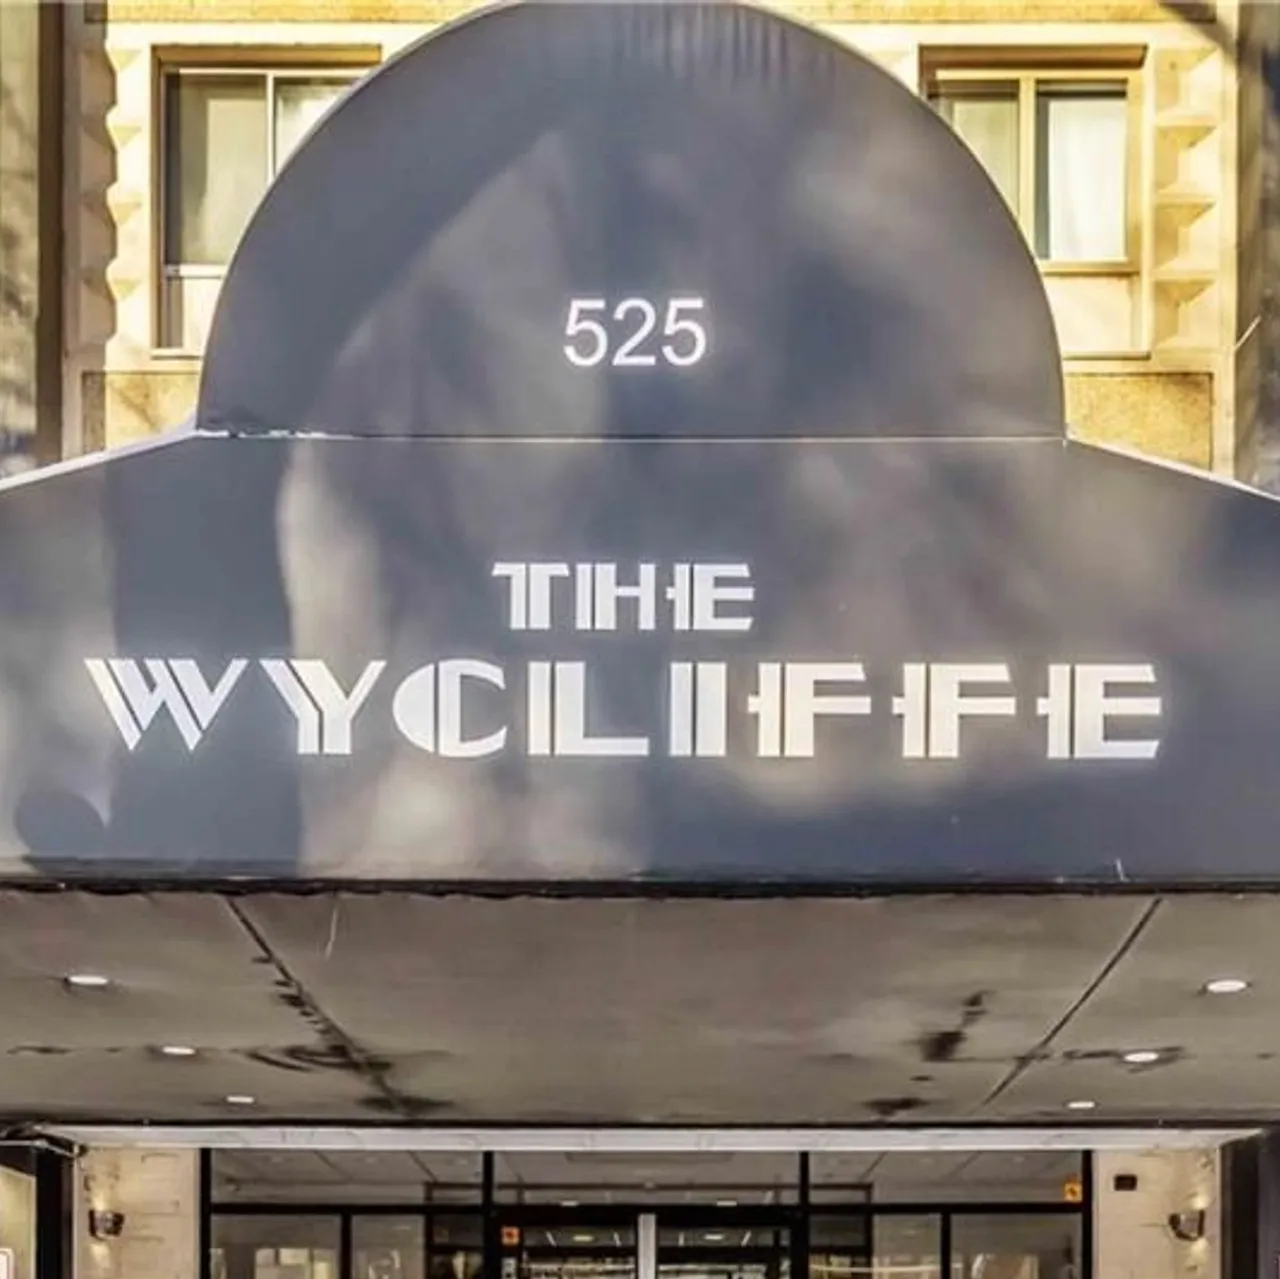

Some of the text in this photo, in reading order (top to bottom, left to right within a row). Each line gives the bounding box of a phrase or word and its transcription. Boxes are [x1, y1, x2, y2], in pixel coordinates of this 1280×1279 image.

[562, 296, 707, 367] 525
[491, 561, 755, 631] THE
[84, 657, 1162, 758] WYCLIFFE
